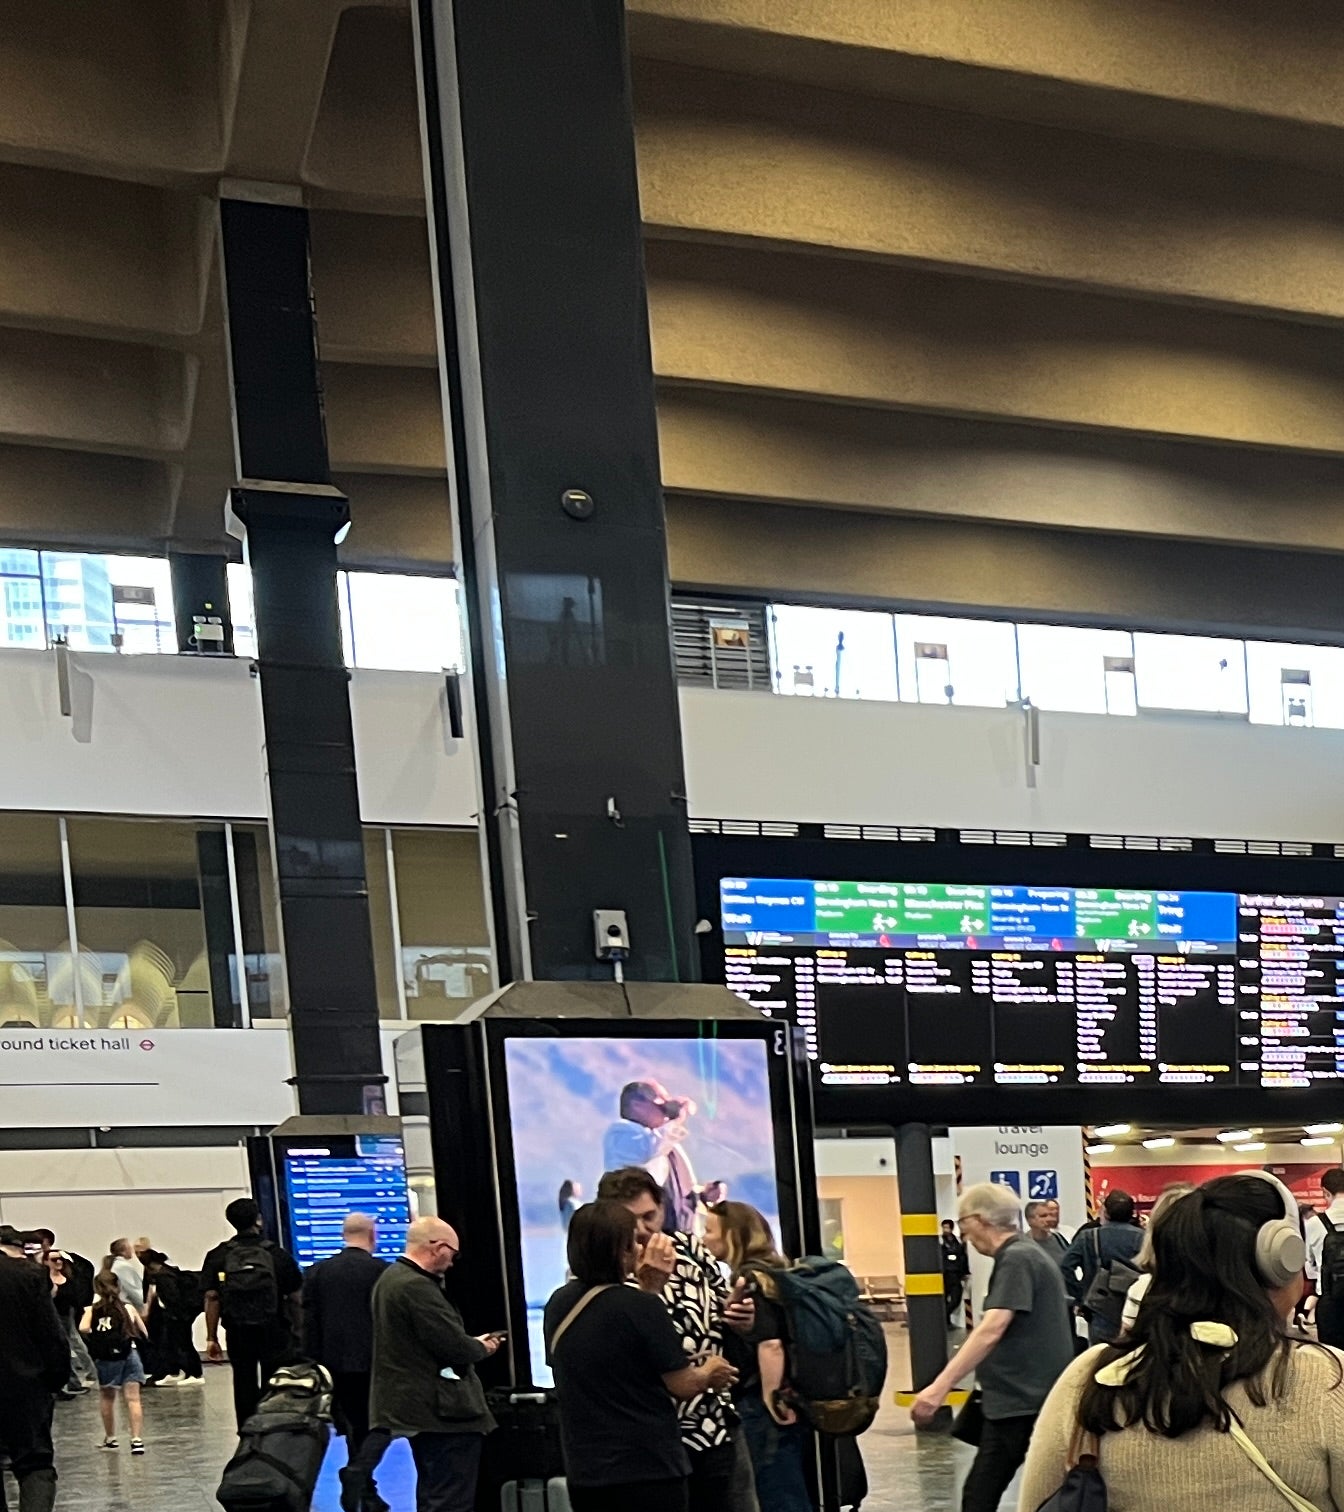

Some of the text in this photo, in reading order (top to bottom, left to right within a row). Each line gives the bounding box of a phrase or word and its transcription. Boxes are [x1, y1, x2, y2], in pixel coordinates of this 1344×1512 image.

[49, 1038, 96, 1050] ticket
[101, 1038, 130, 1050] hall
[995, 1142, 1048, 1156] lounge
